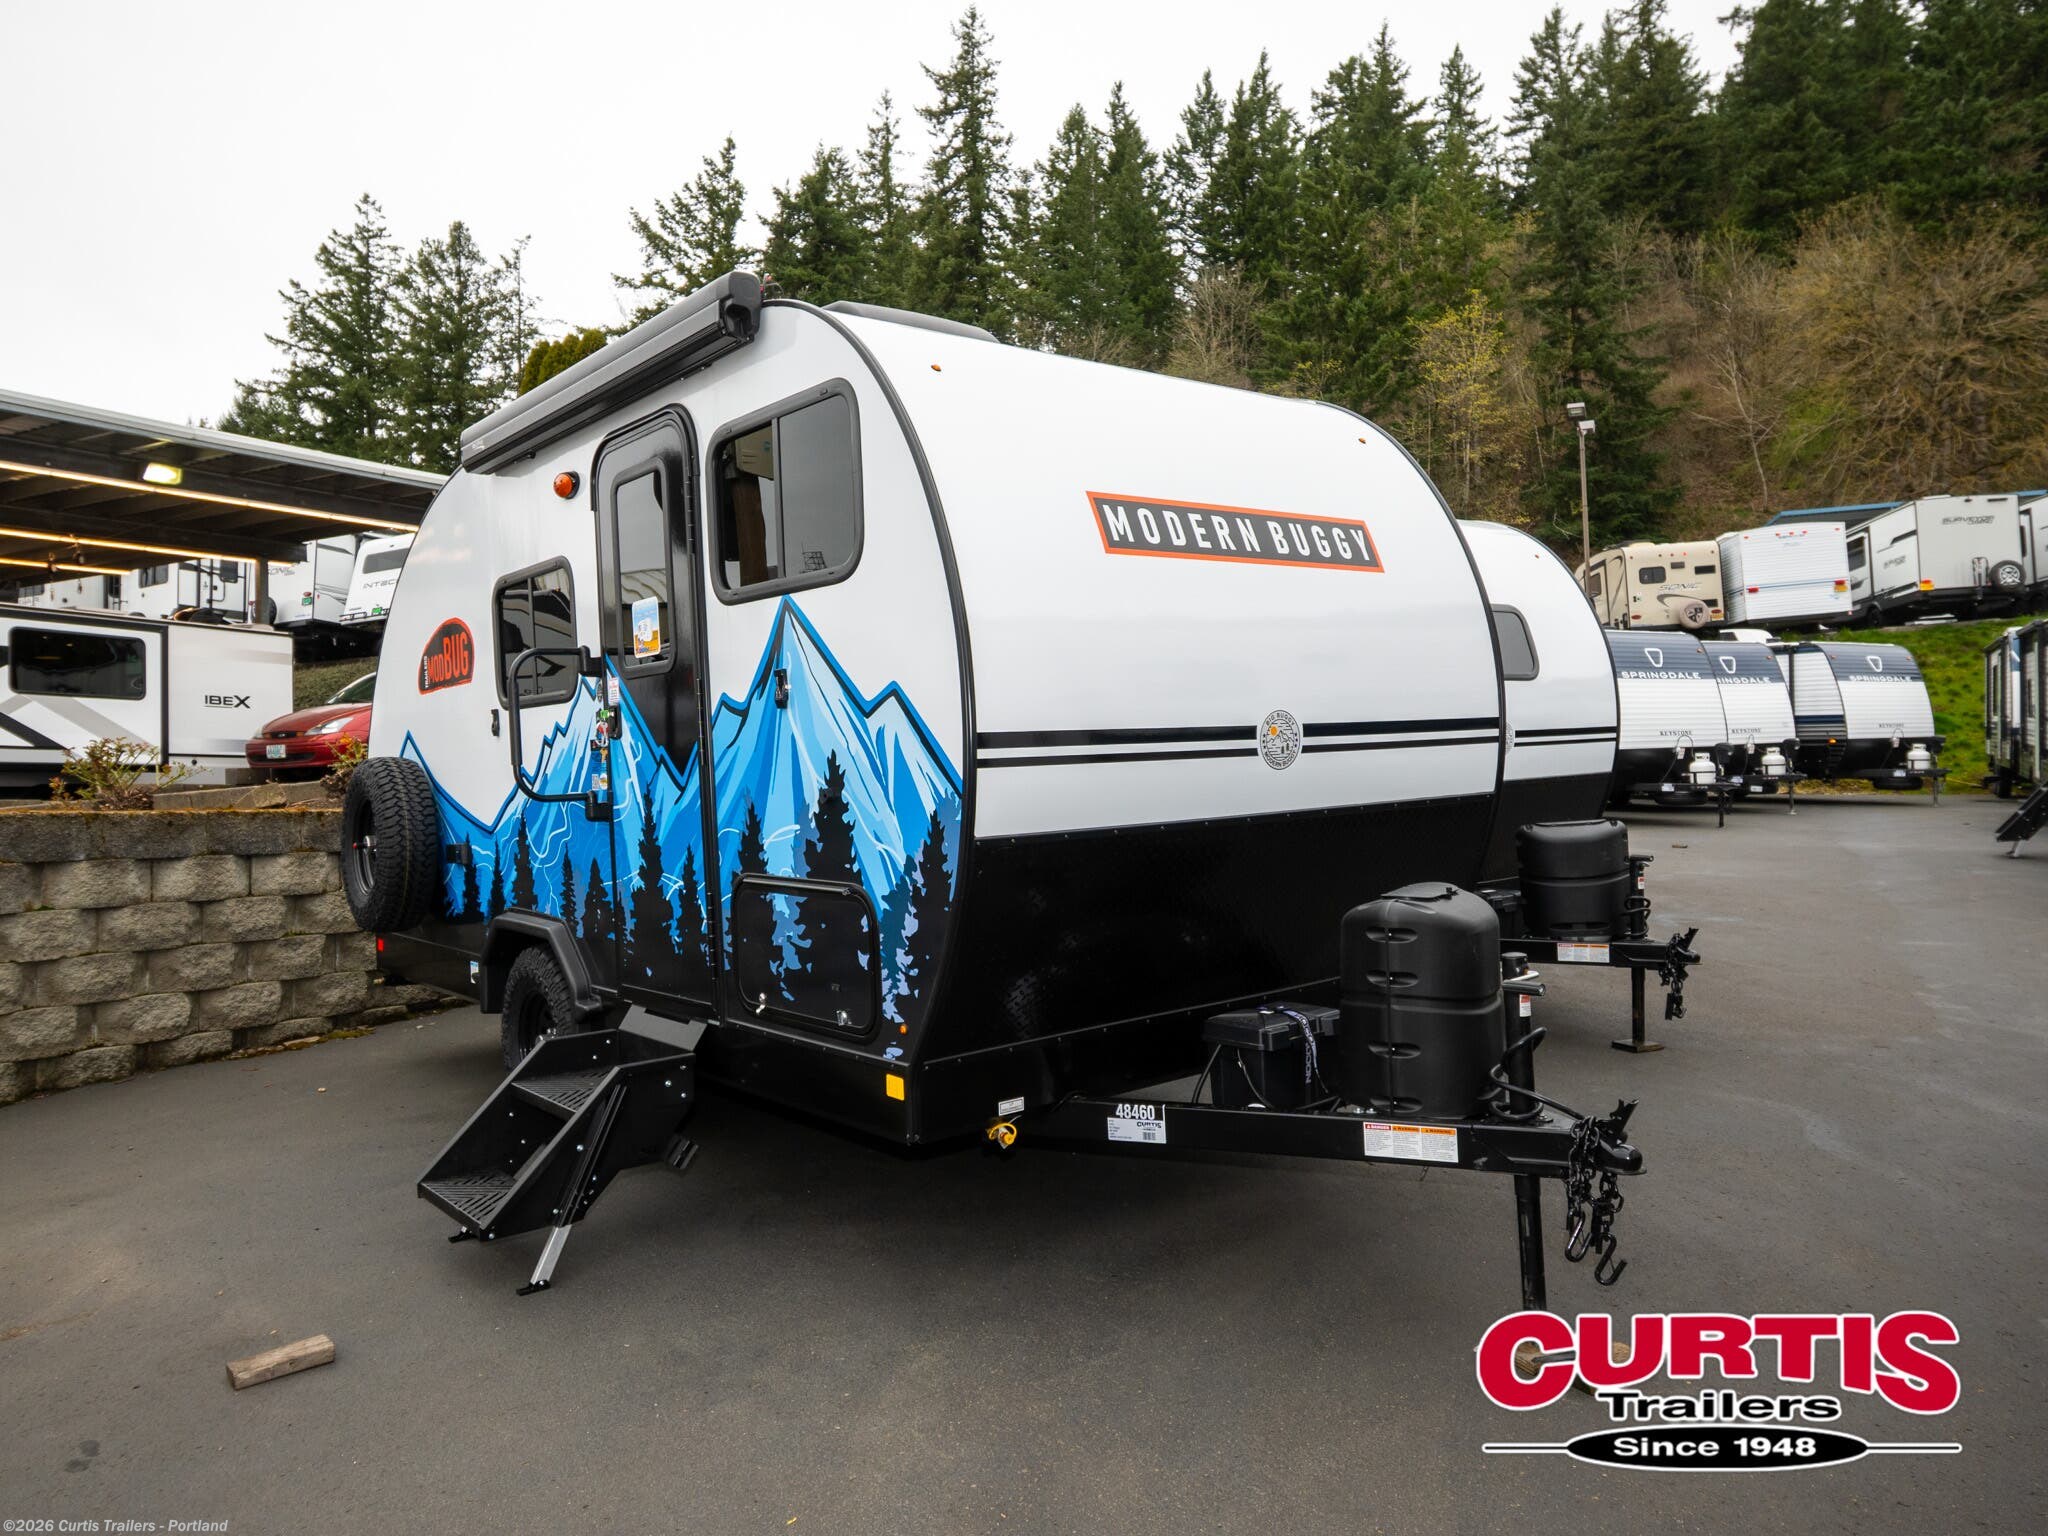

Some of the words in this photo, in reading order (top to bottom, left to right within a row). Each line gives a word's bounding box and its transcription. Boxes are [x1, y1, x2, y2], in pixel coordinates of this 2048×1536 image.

[1102, 504, 1261, 552] MODERN
[1266, 520, 1370, 561] BUGGY
[1621, 671, 1701, 680] SPRINGDALE
[204, 695, 251, 709] IBEX
[1115, 1104, 1156, 1120] 48460
